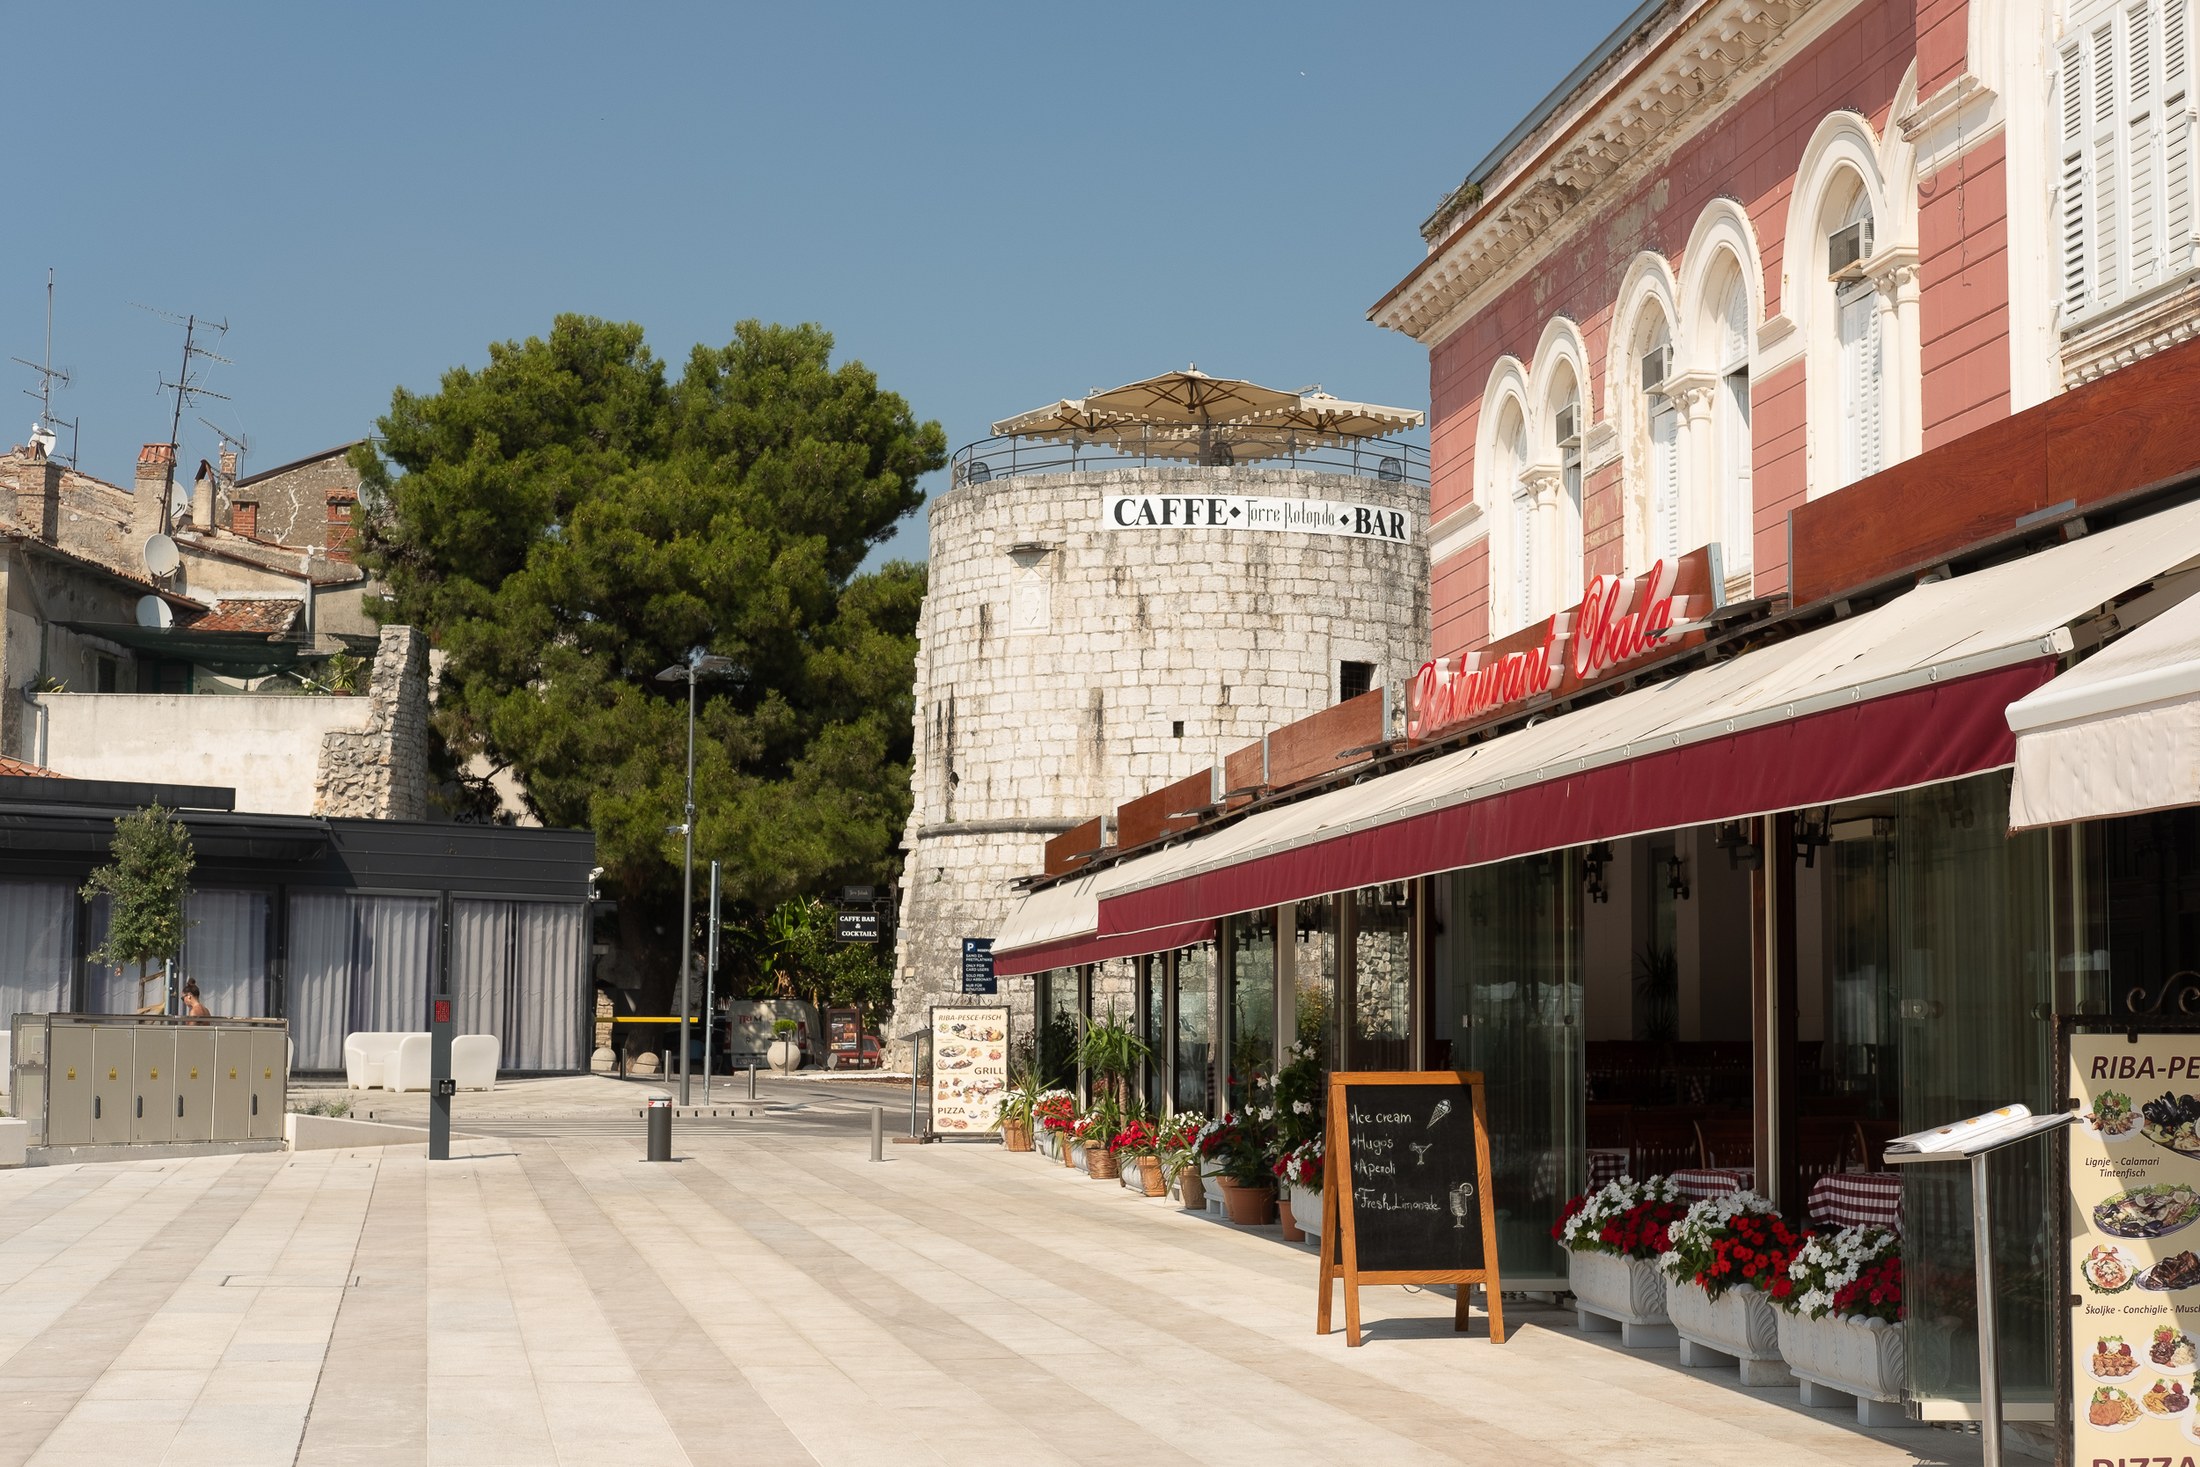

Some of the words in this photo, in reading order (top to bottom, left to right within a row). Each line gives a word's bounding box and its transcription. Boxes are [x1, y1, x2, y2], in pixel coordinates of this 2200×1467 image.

[1114, 498, 1229, 526] CAFFE
[1245, 499, 1280, 527] Torre
[1285, 501, 1335, 529] Rotonda
[1354, 507, 1406, 540] BAR
[1408, 613, 1564, 740] Restaurant
[1573, 558, 1682, 680] Obala
[967, 942, 974, 951] P
[974, 1067, 1004, 1075] GRILL
[1354, 1104, 1373, 1125] Ice
[1376, 1113, 1412, 1124] cream
[2085, 1157, 2111, 1167] Lignje
[2120, 1157, 2160, 1166] Calamari
[2100, 1168, 2146, 1179] Tintenfisch
[1358, 1187, 1392, 1210] Fresh
[2085, 1304, 2115, 1316] Školjke
[2123, 1305, 2168, 1315] Conchiglie
[2175, 1304, 2200, 1313] Musc
